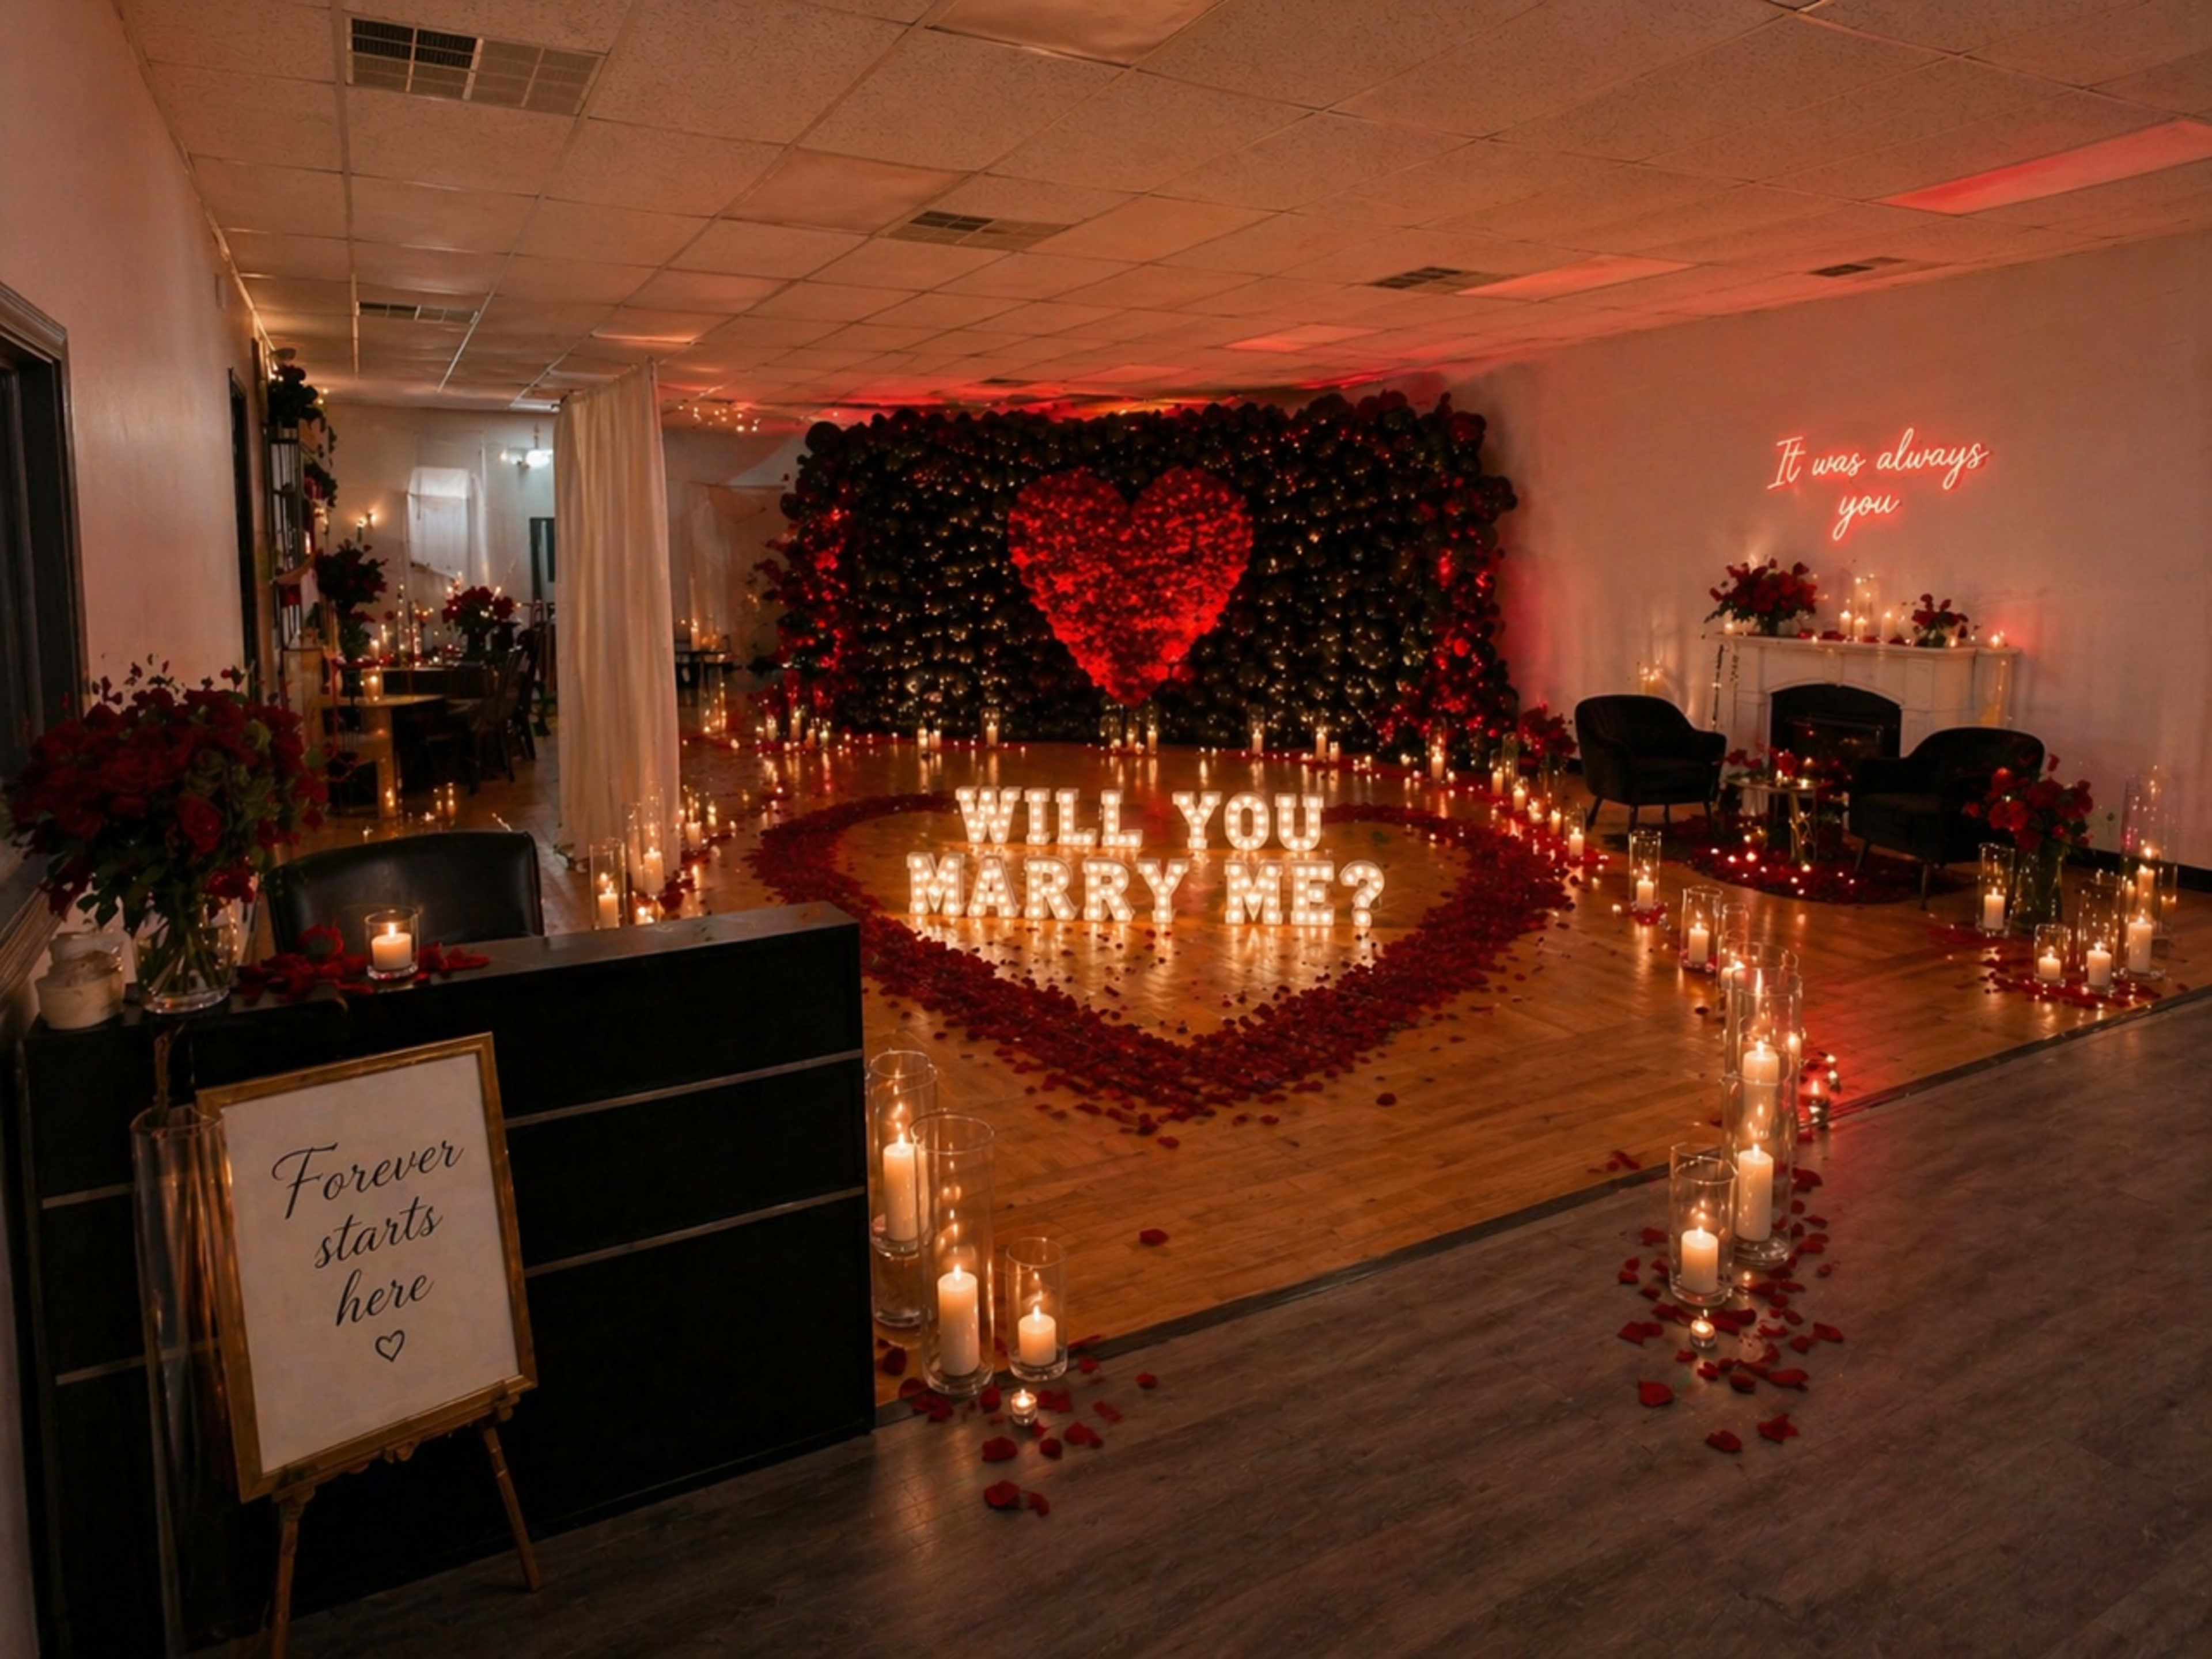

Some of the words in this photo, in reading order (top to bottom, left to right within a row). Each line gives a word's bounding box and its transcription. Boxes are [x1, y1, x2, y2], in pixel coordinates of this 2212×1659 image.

[1766, 436, 1806, 490] It
[1811, 452, 1866, 477] was
[1876, 427, 1990, 490] always
[1832, 493, 1901, 541] you
[955, 786, 1143, 849] WILL
[1172, 791, 1324, 851] YOU
[907, 852, 1190, 922] MARRY
[1225, 859, 1385, 926] ME?
[271, 1139, 464, 1220] Forever
[314, 1196, 444, 1268] starts
[336, 1268, 434, 1327] here
